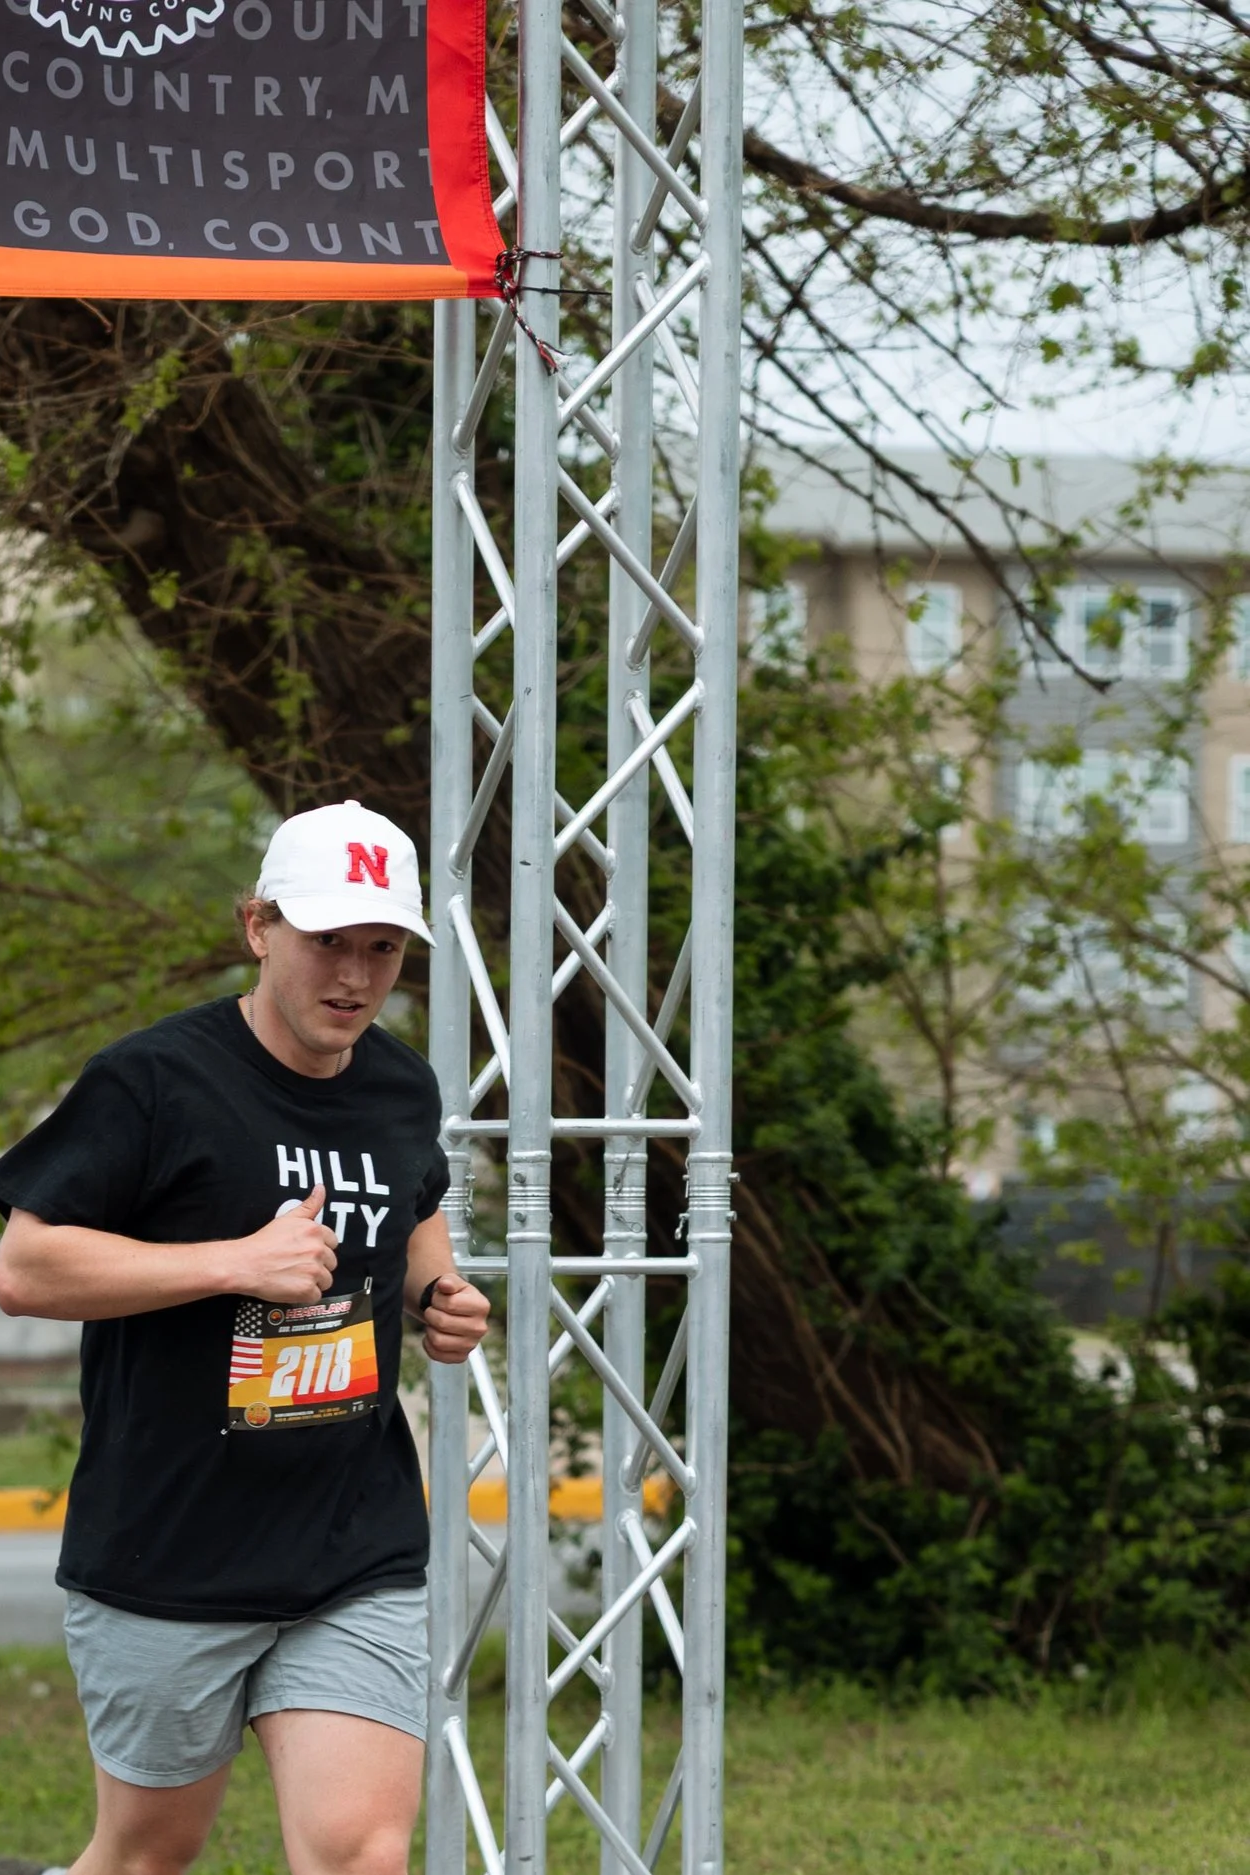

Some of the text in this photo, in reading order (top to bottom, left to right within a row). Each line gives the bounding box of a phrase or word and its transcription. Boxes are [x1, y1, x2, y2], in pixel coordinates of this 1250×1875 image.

[2, 50, 333, 120] COUNTRY,
[366, 74, 410, 116] M
[204, 218, 440, 256] COUNT
[345, 842, 390, 890] N
[276, 1145, 390, 1196] HILL
[268, 1337, 353, 1398] 2118
